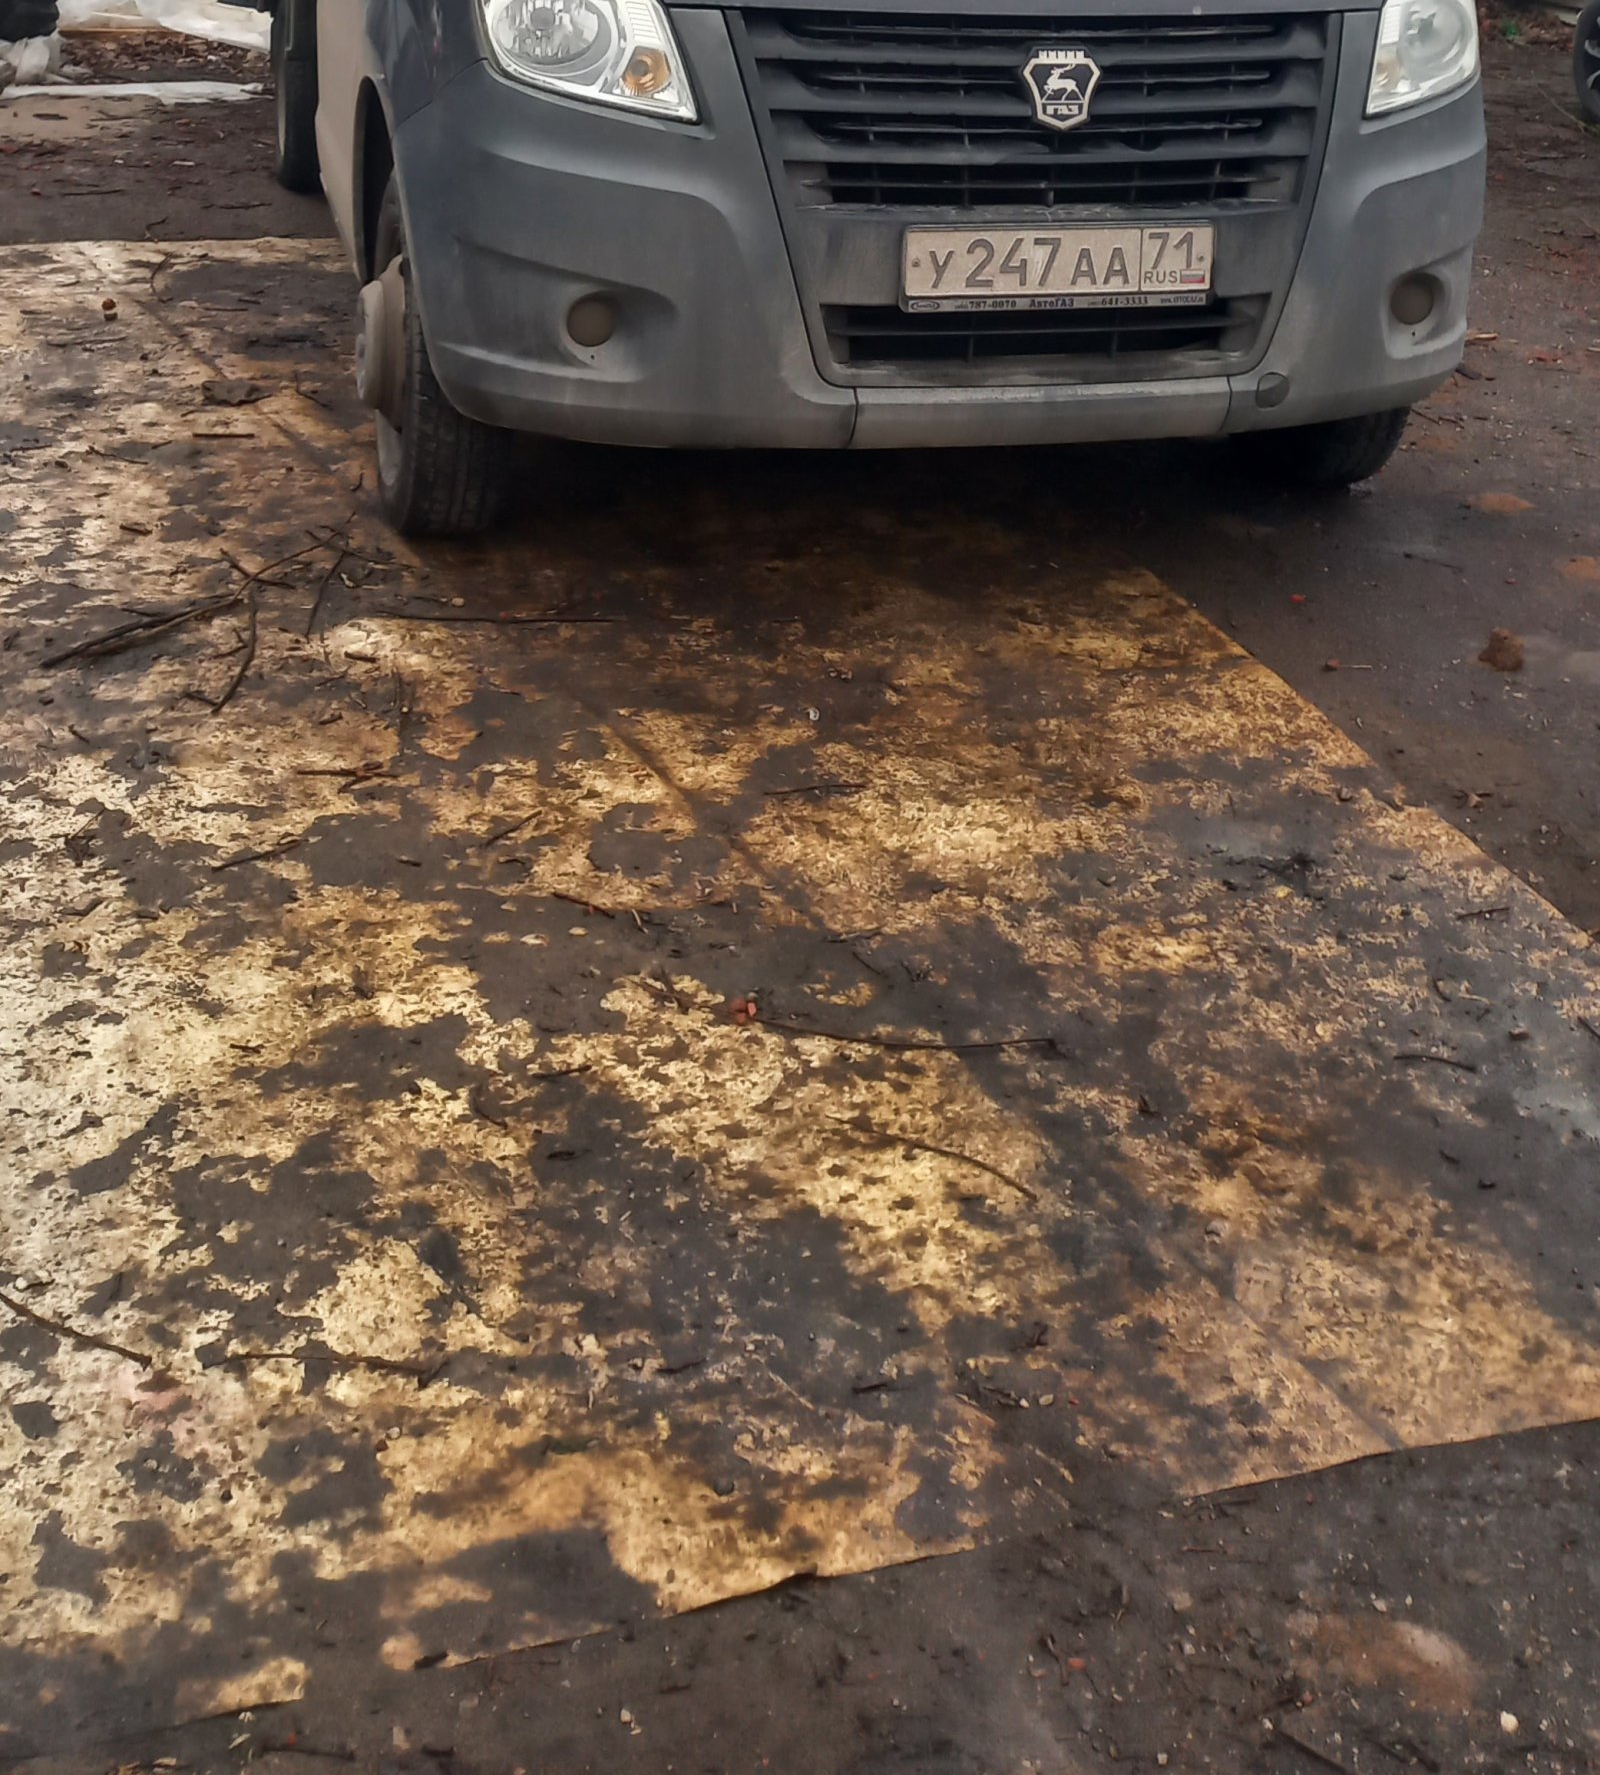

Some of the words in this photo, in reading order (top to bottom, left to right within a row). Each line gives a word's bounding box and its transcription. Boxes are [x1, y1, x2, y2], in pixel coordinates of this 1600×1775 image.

[1046, 104, 1079, 115] ГАЗ
[1147, 231, 1195, 270] 71
[1143, 269, 1178, 285] RUS
